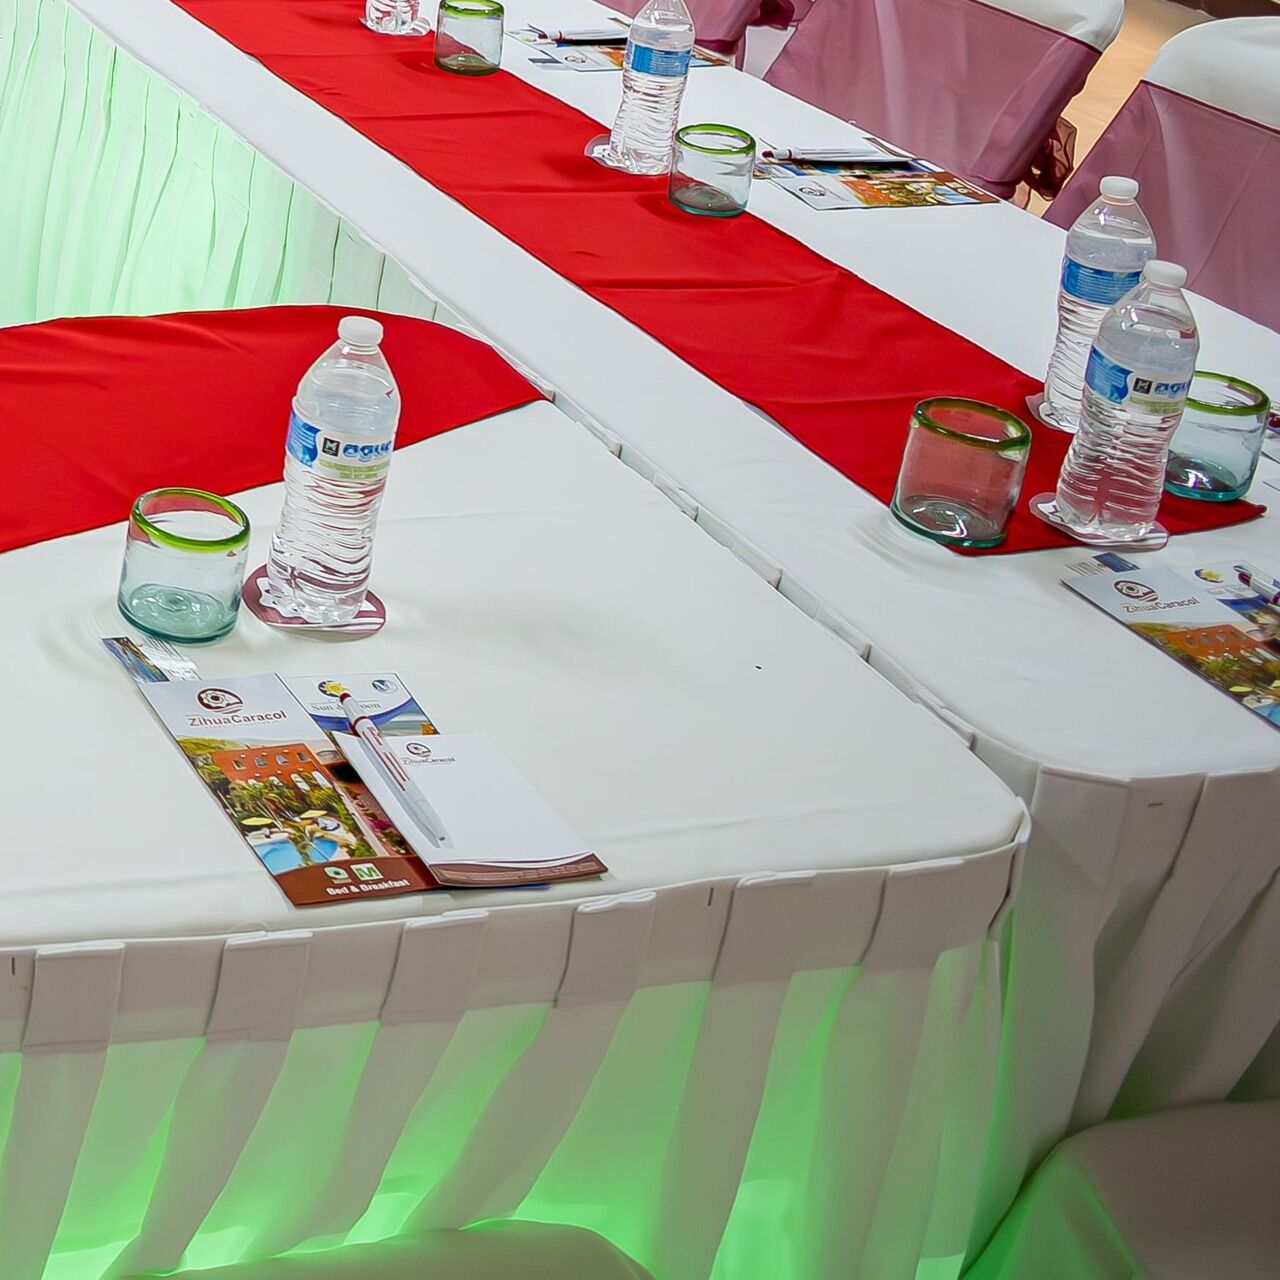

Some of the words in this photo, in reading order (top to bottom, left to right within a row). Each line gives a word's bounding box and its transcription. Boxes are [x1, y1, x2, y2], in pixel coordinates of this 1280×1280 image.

[188, 709, 287, 727] ZihuaCaracol
[326, 884, 350, 896] Bed
[359, 879, 411, 892] Breakfast
